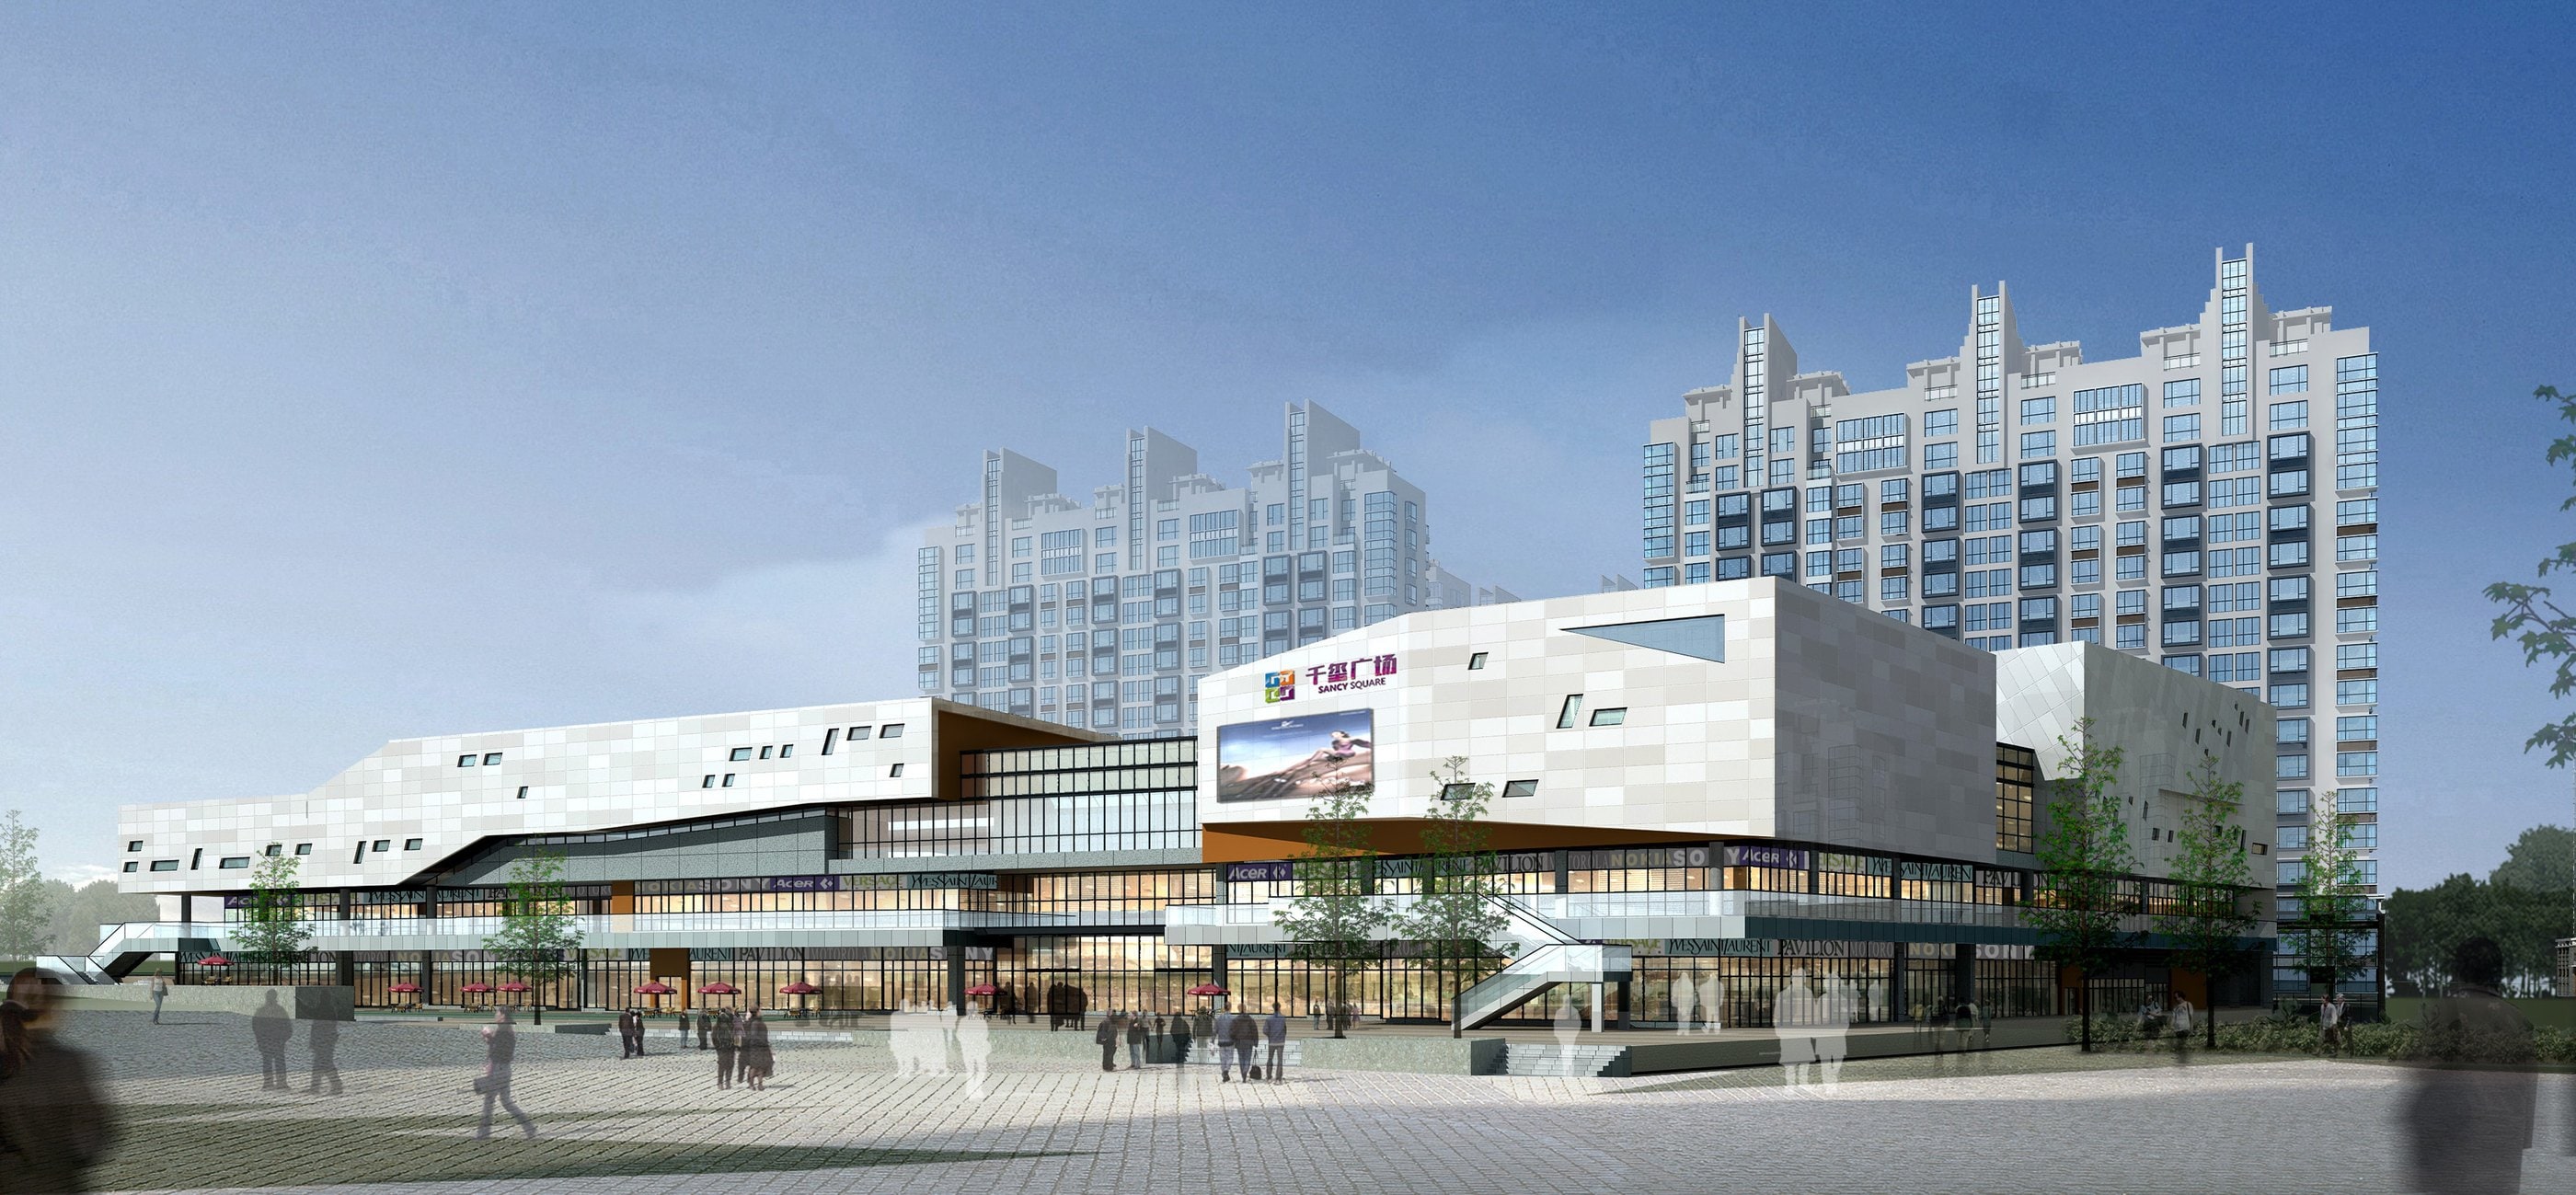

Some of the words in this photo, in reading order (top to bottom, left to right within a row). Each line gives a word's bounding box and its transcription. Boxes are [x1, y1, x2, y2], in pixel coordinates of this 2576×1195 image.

[1305, 653, 1397, 685] 千玺广场
[1318, 683, 1349, 695] SANCY
[1350, 678, 1386, 690] SQUARE
[1610, 853, 1673, 867] NOKIA
[698, 878, 767, 891] SONY
[739, 948, 802, 960] PAVILION
[810, 948, 868, 960] MOTOROLA
[870, 948, 927, 959] NOKIA
[1777, 939, 1844, 956] PAVILION
[397, 952, 451, 962] NOIA
